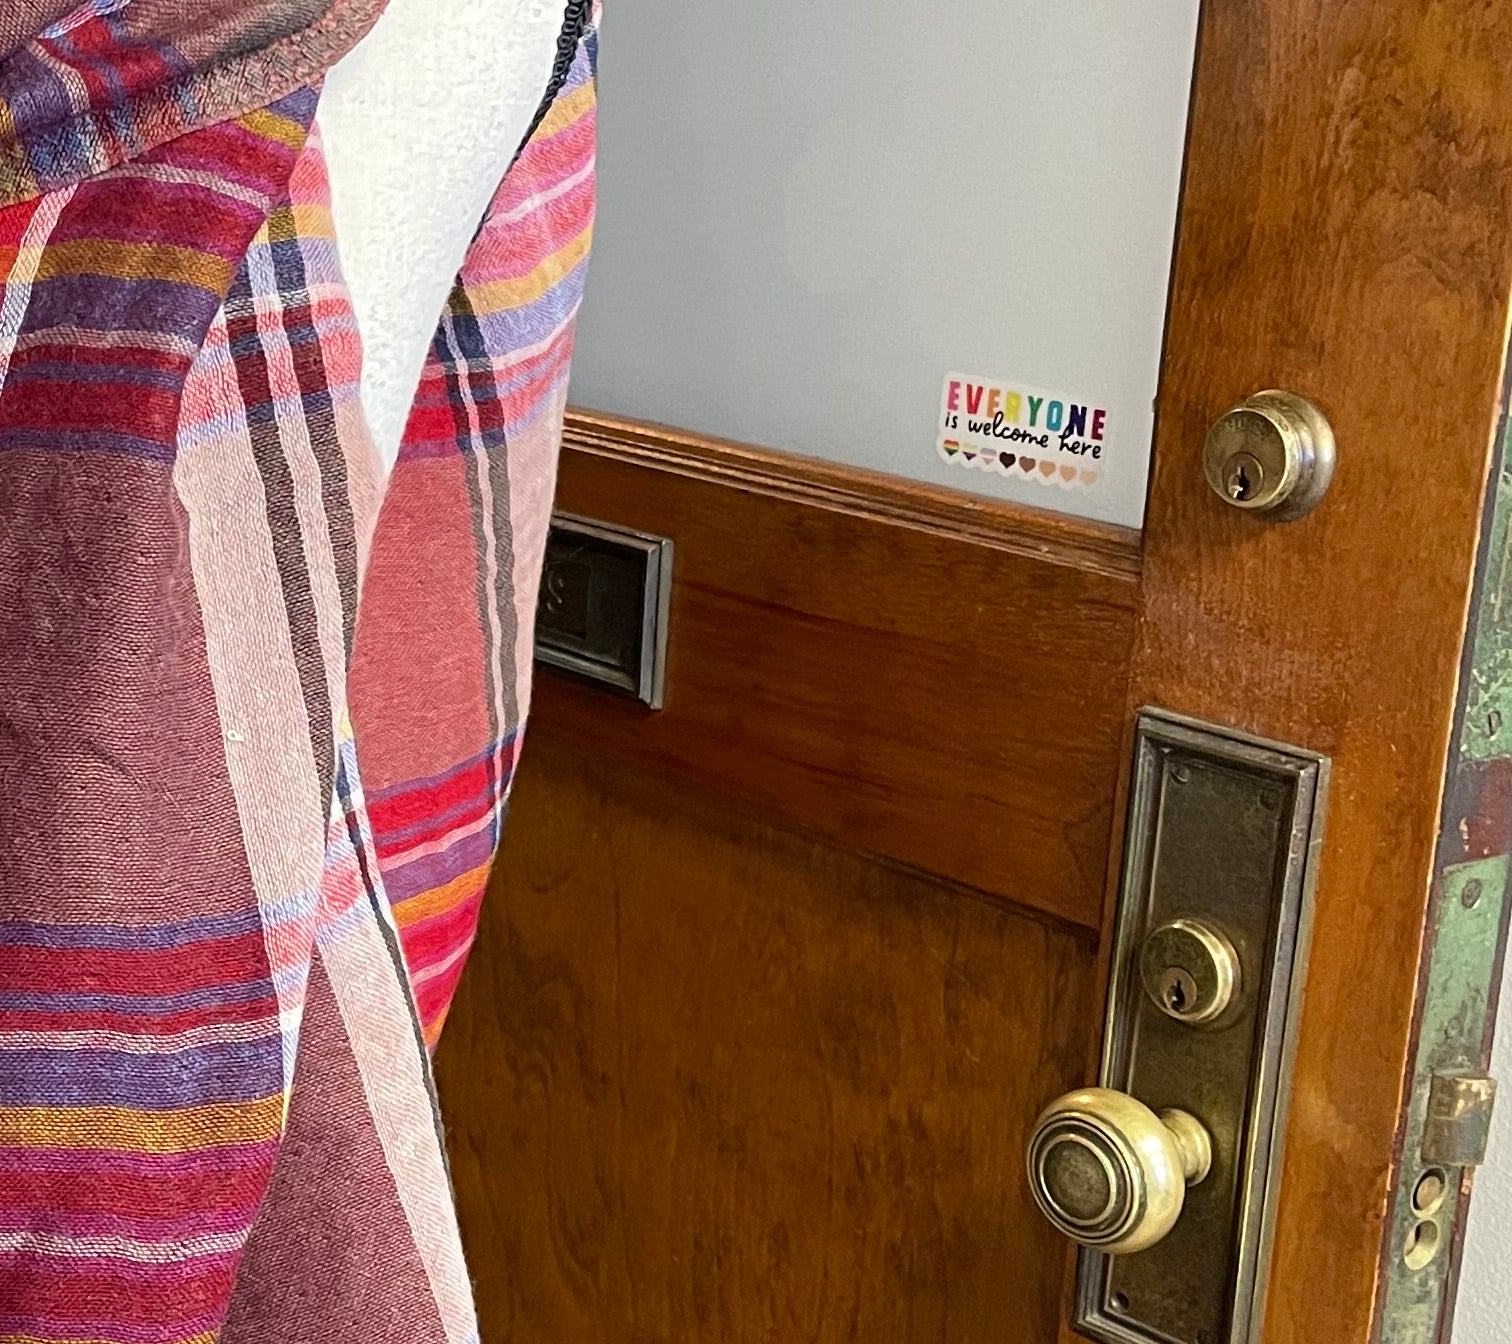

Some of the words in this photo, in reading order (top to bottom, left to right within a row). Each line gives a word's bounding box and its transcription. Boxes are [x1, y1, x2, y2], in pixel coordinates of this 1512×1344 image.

[944, 411, 959, 430] is
[968, 411, 1049, 448] welcome
[1058, 424, 1102, 460] here
[946, 380, 1107, 441] EVERYONE
